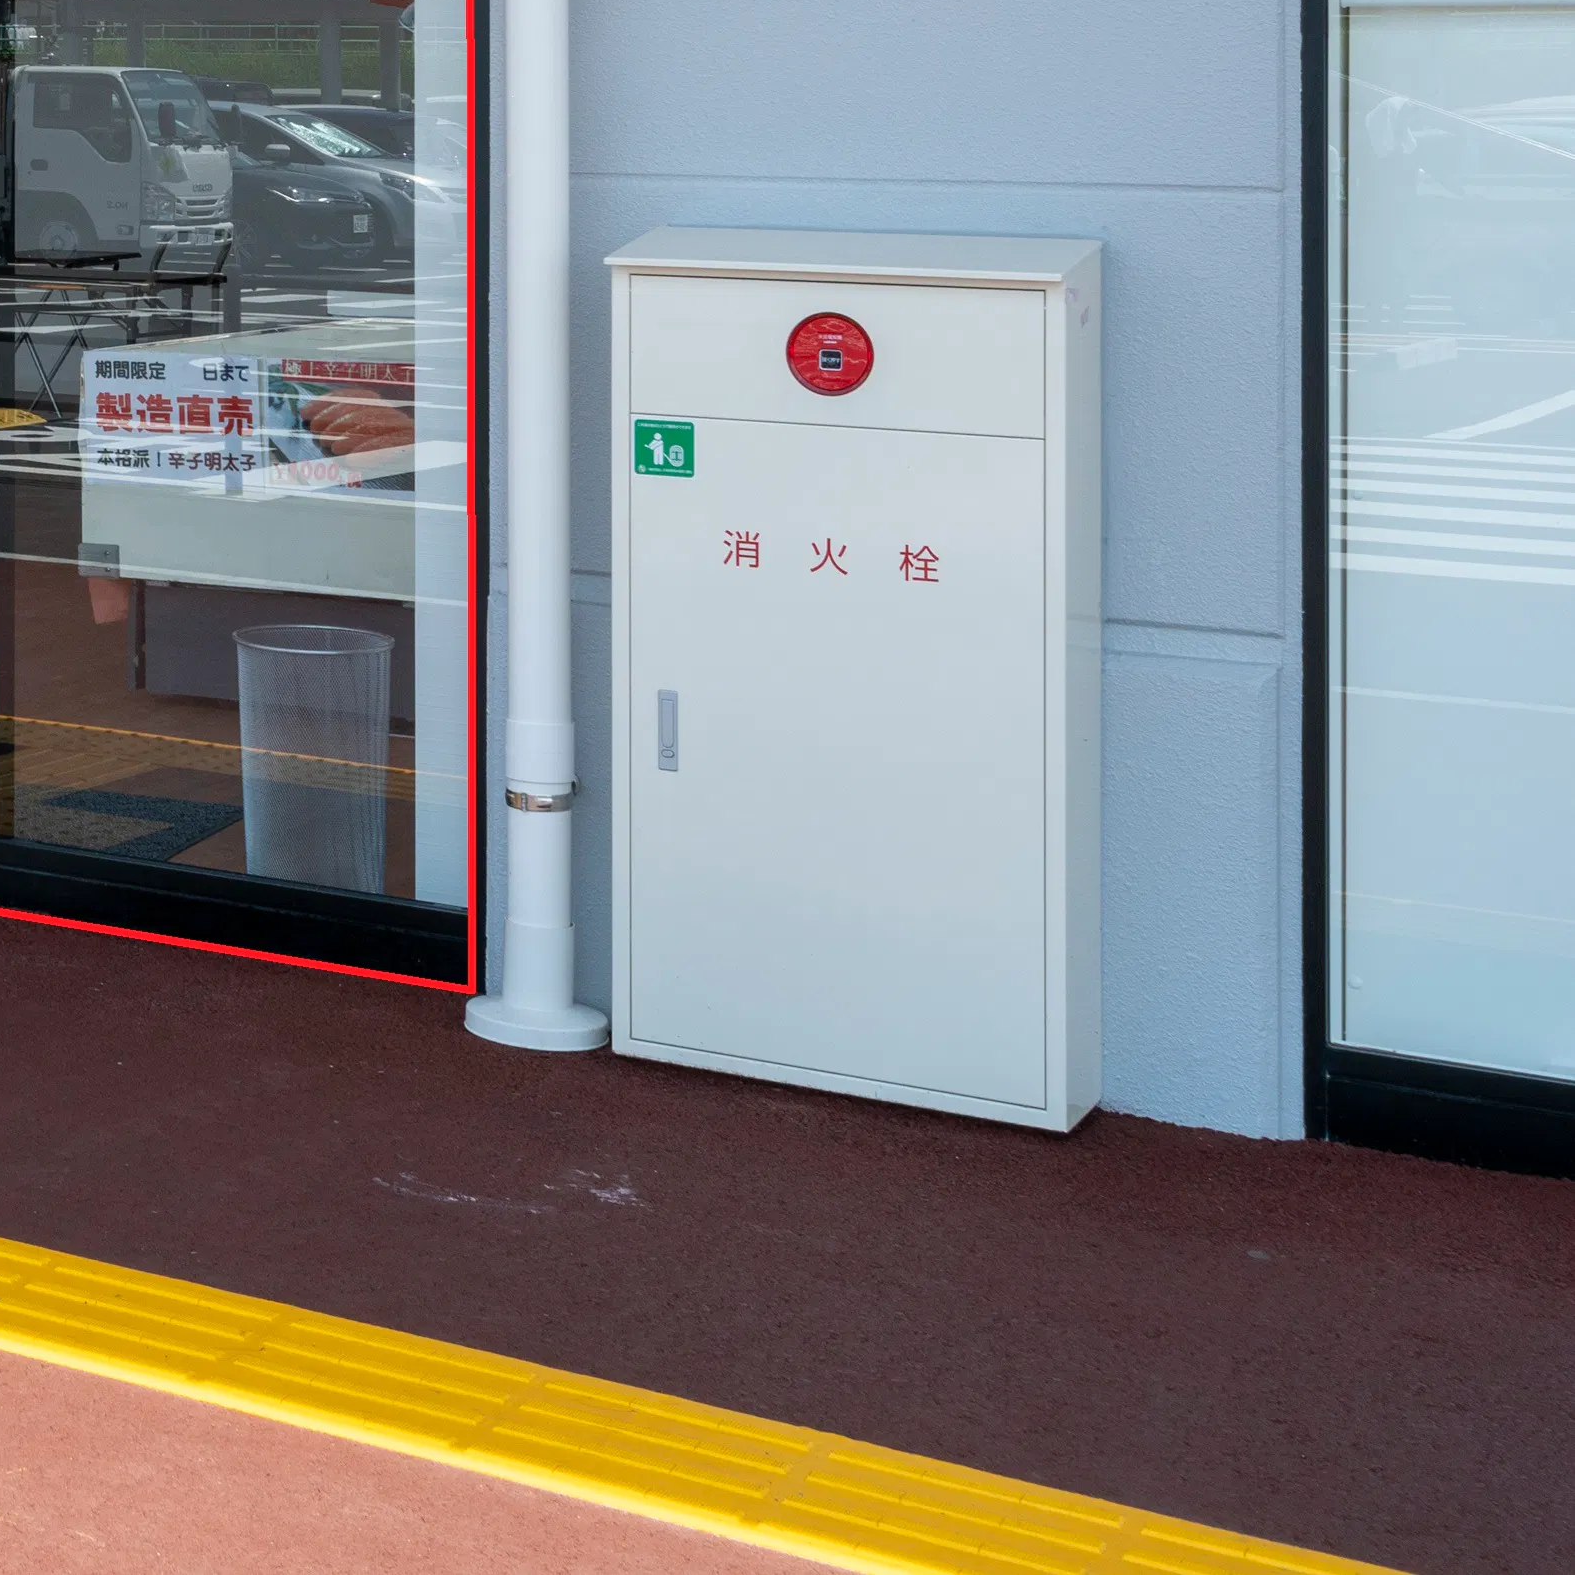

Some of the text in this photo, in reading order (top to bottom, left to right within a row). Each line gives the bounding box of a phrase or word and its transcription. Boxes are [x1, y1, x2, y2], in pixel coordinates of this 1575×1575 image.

[94, 359, 250, 383] 期間限定 日まで
[95, 391, 255, 437] 製造直売
[723, 529, 940, 583] 消火栓
